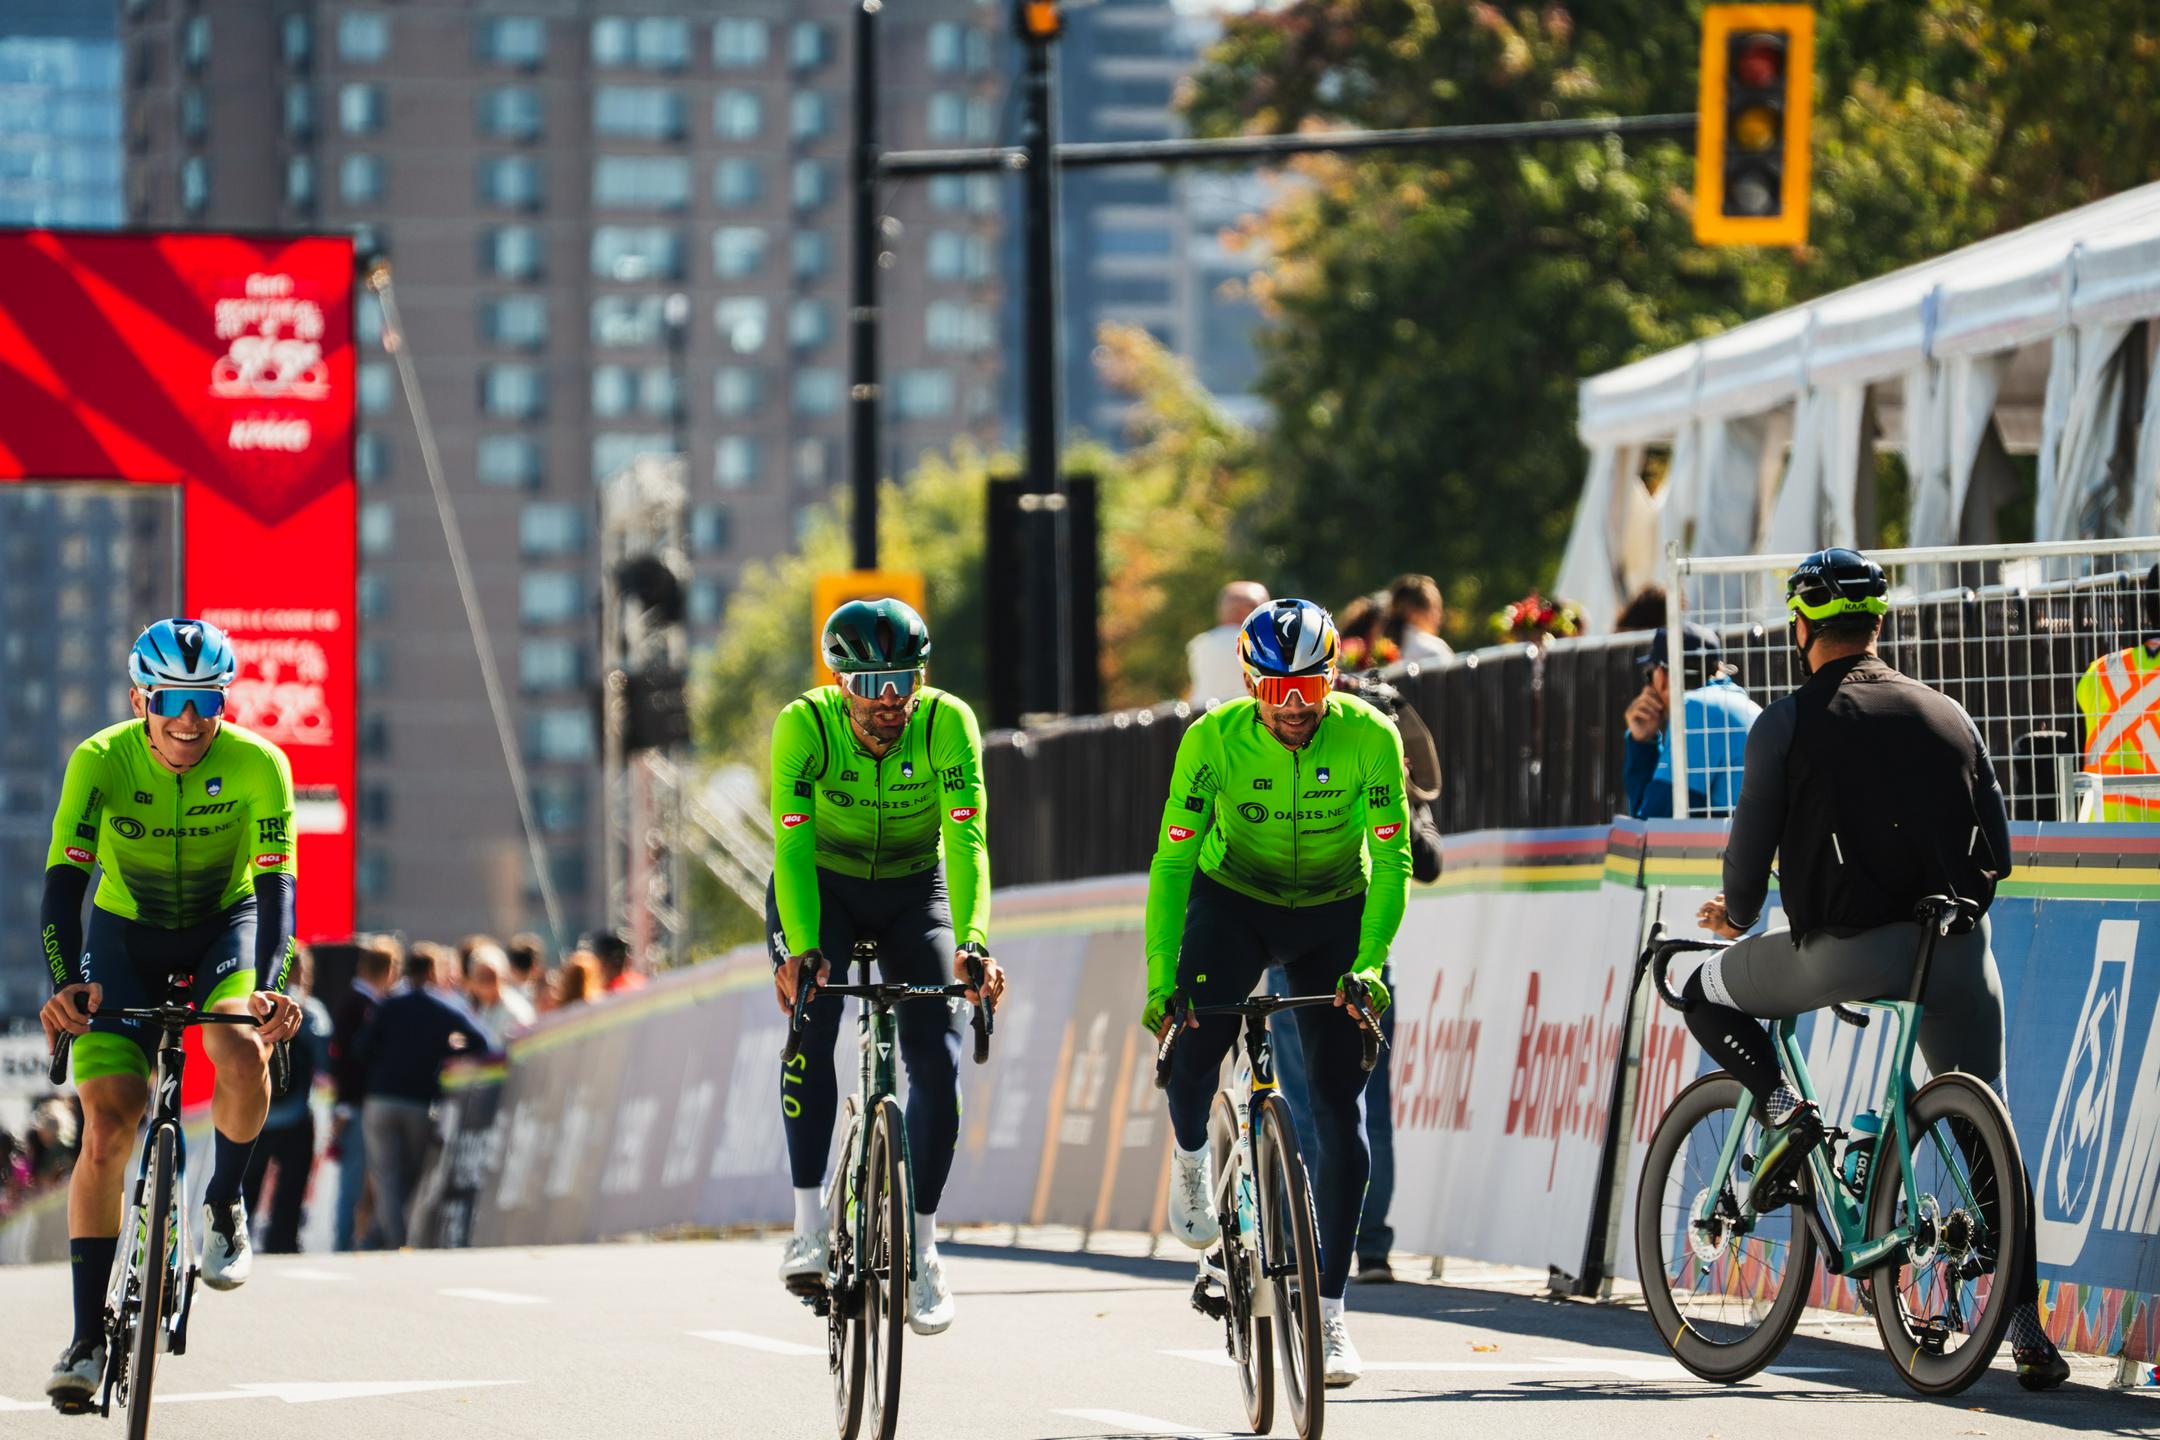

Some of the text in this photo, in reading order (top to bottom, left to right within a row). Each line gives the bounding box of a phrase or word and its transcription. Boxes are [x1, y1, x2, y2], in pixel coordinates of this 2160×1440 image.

[942, 765, 963, 779] TRI
[944, 778, 965, 794] MO
[1368, 784, 1389, 798] TRI
[1303, 789, 1346, 799] DMT
[1369, 797, 1390, 809] MO
[784, 815, 802, 823] MOL
[953, 808, 970, 818] MOL
[256, 817, 288, 831] TRI
[259, 831, 287, 843] MO
[1170, 827, 1187, 838] MOL
[1377, 826, 1394, 836] MOL
[68, 848, 90, 860] MOL
[258, 854, 281, 863] MOL
